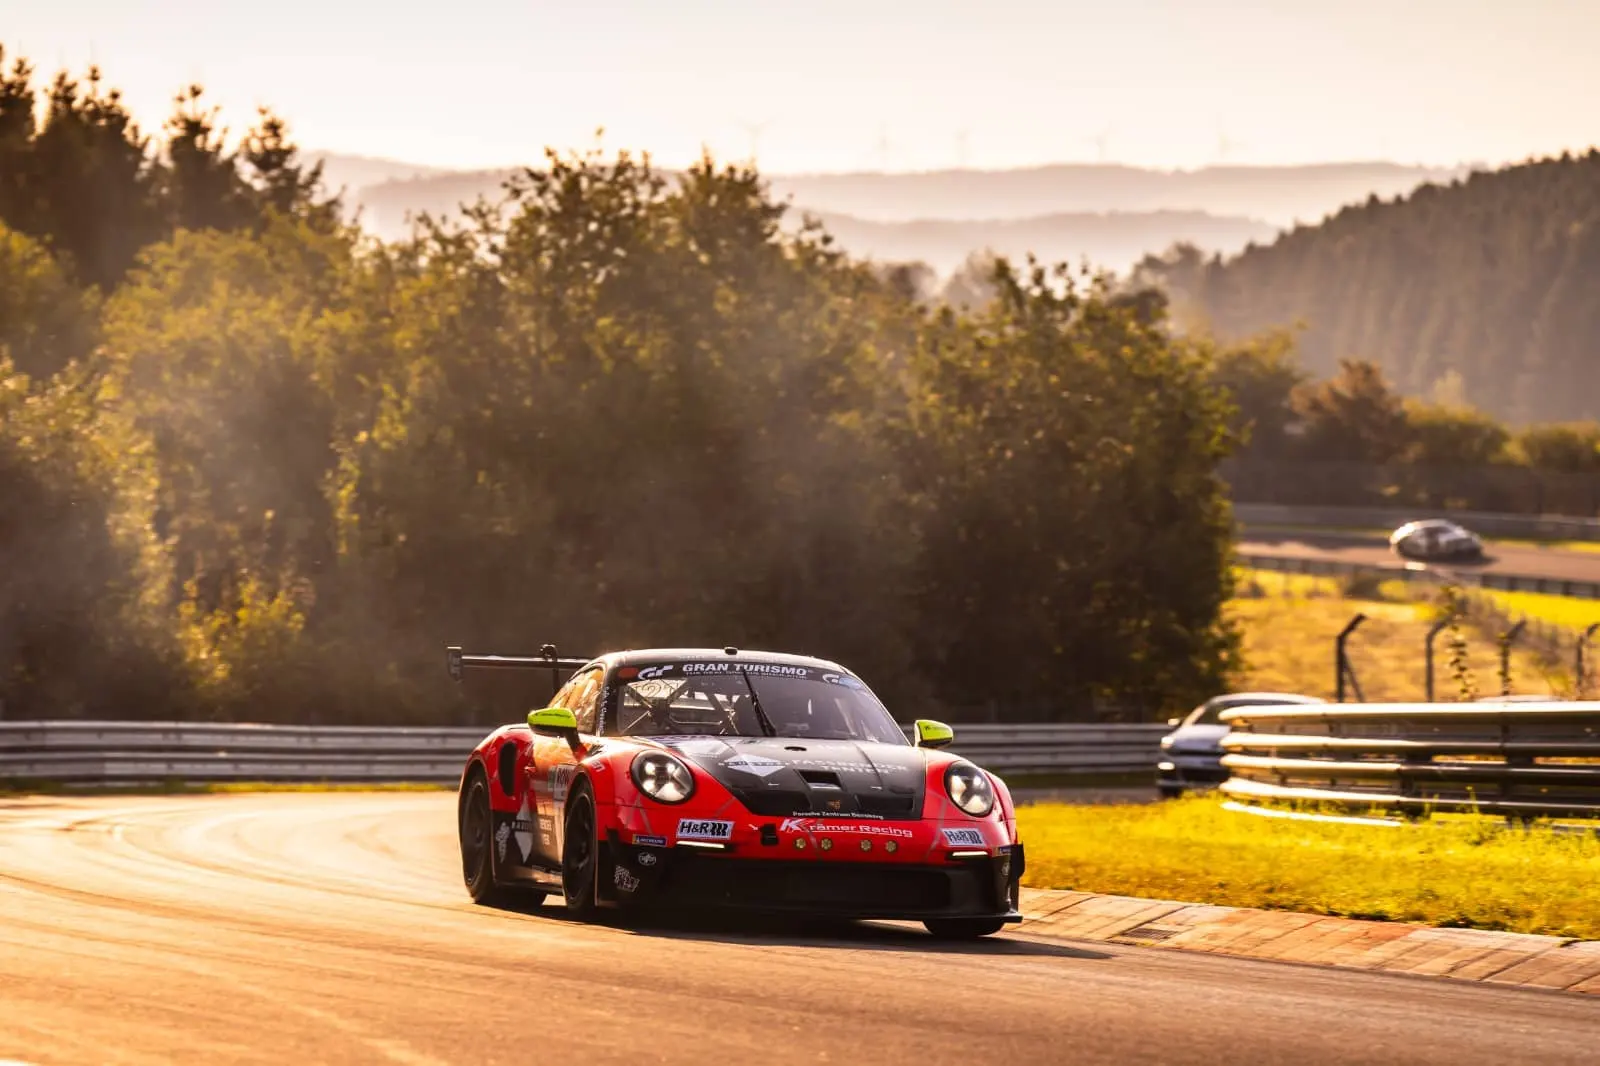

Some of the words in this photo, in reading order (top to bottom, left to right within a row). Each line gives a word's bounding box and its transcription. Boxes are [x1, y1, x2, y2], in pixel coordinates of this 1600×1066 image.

[682, 663, 729, 672] GRAN
[734, 664, 807, 676] TURISMO
[779, 818, 856, 832] Krämer
[859, 825, 913, 838] Racing
